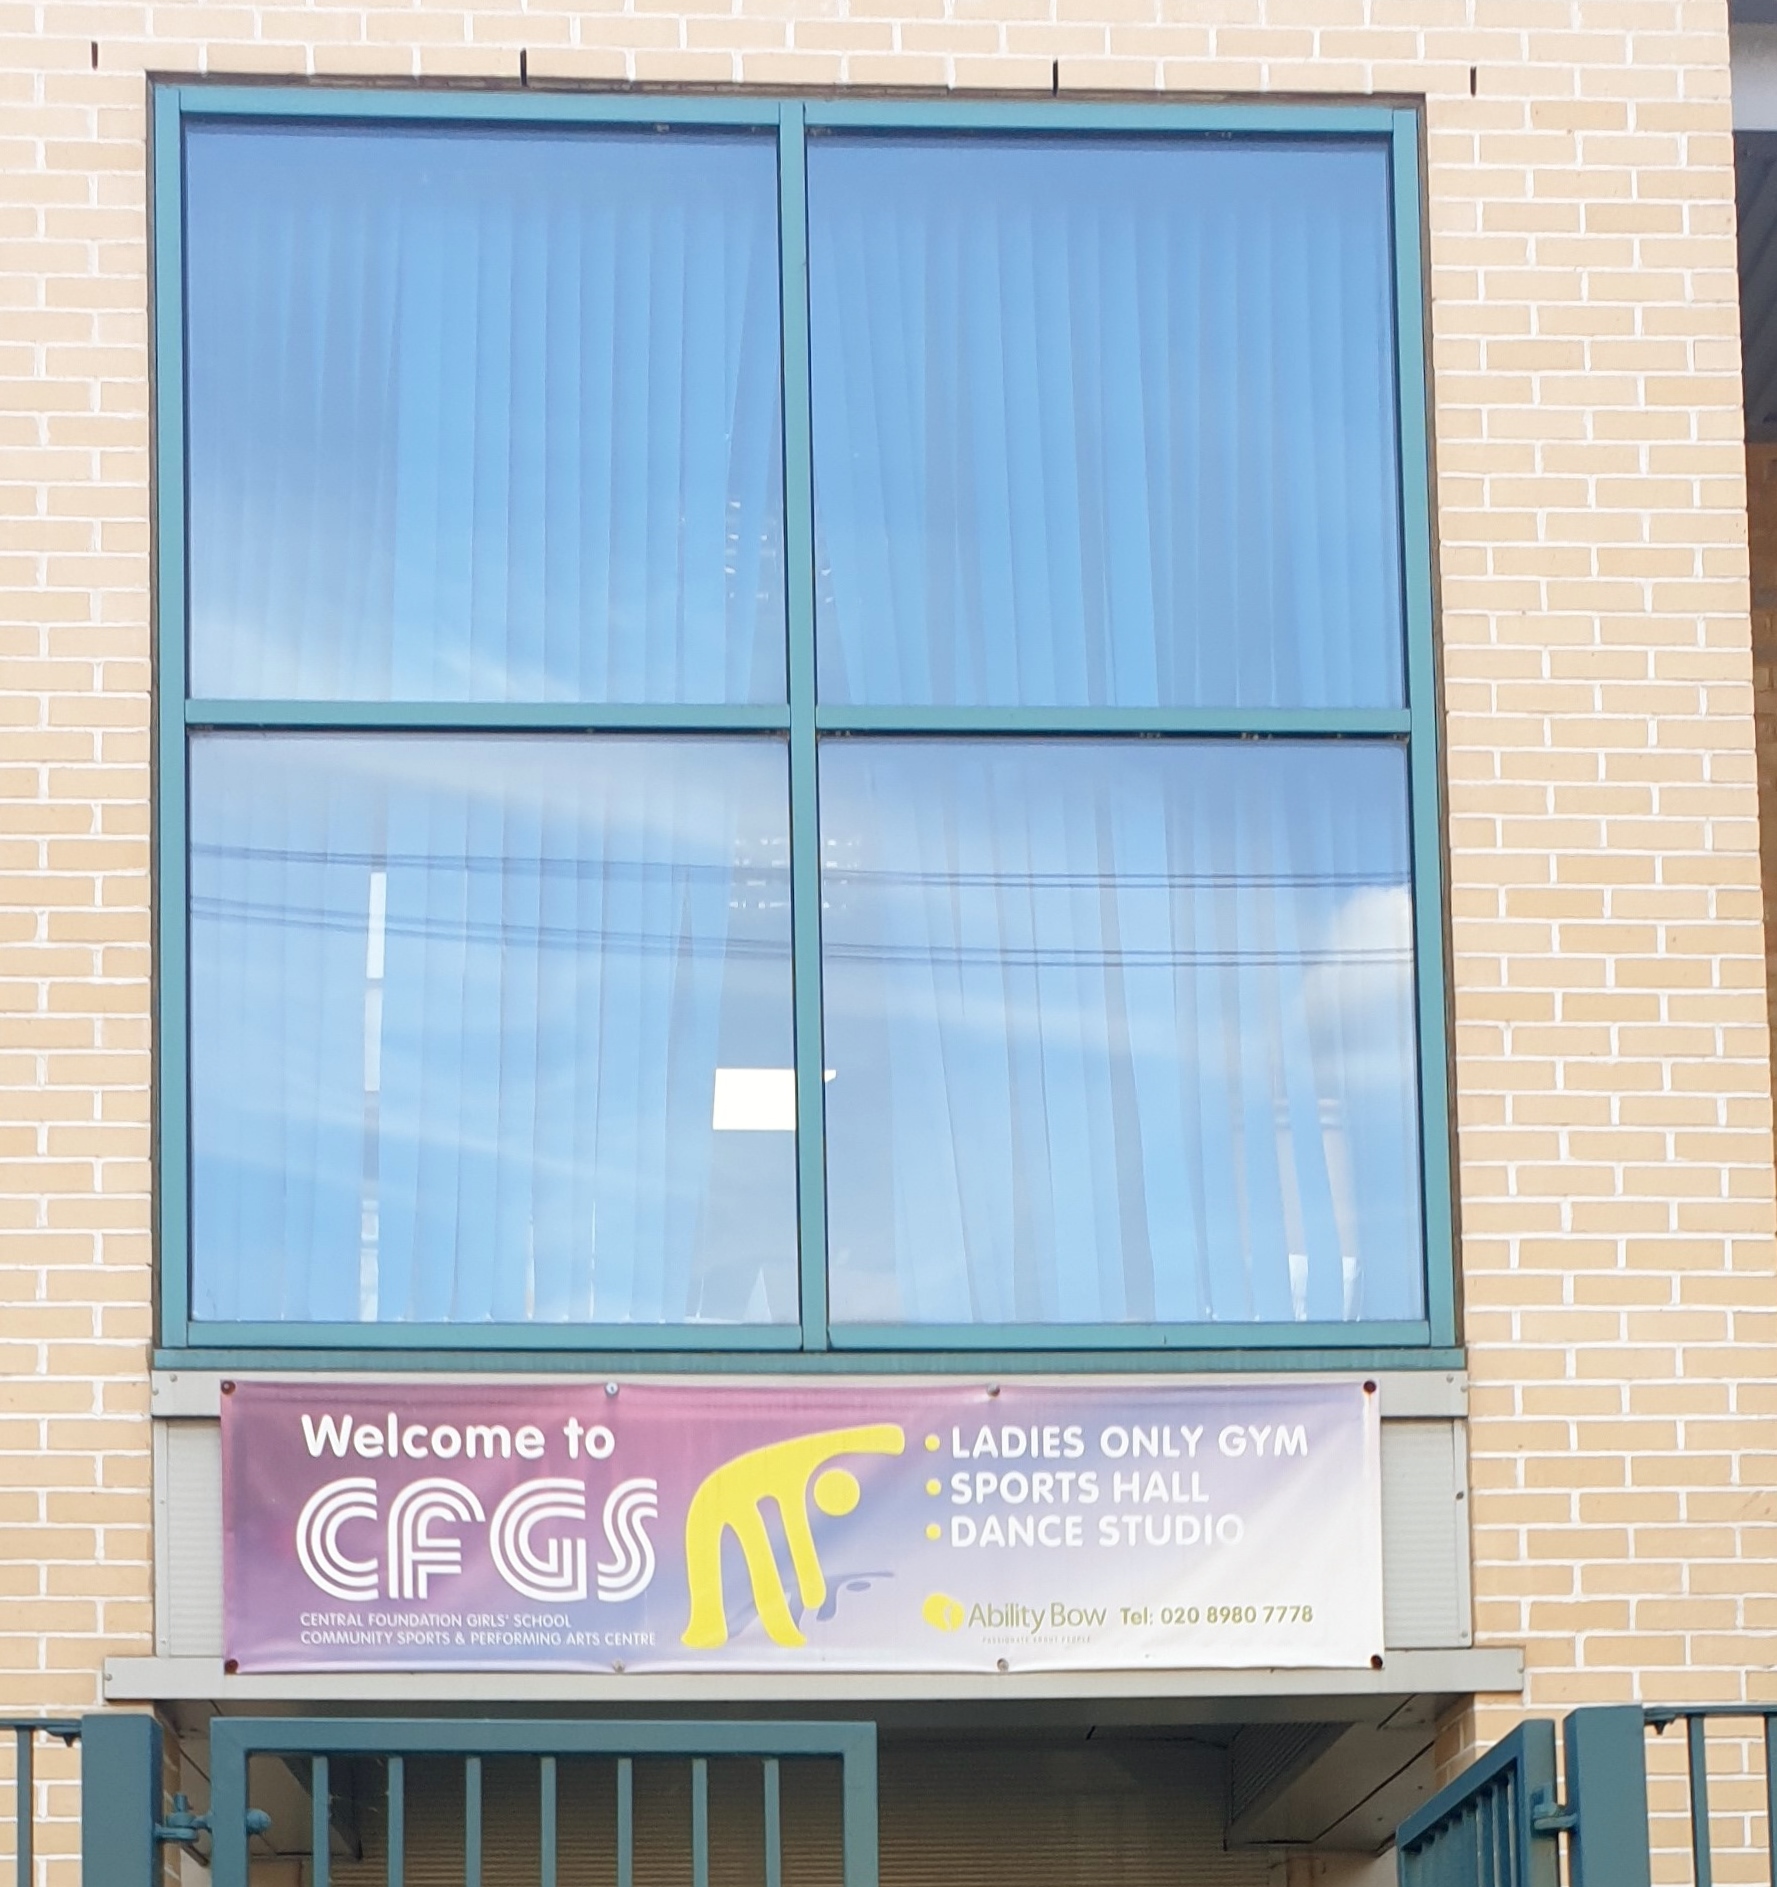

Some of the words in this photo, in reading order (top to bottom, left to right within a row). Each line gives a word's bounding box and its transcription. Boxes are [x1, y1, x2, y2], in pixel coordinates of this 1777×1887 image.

[301, 1412, 545, 1459] Welcome
[563, 1416, 615, 1460] to
[951, 1425, 1085, 1458] LADIES
[1100, 1424, 1204, 1458] ONLY
[1217, 1423, 1309, 1457] GYM
[951, 1471, 1099, 1505] SPORTS
[1113, 1470, 1210, 1504] HALL
[296, 1477, 658, 1602] CFGS
[951, 1515, 1084, 1548] DANCE
[1099, 1513, 1245, 1547] STUDIO
[300, 1612, 364, 1627] CENTRAL
[368, 1613, 463, 1627] FOUNDATION
[466, 1613, 509, 1628] GIRLS'
[513, 1614, 572, 1628] SCHOOL
[968, 1602, 1045, 1635] Ability
[1050, 1601, 1107, 1627] Bow
[1120, 1607, 1155, 1626] Tel:
[1160, 1606, 1200, 1625] 020
[1206, 1606, 1257, 1625] 8980
[1263, 1604, 1314, 1624] 7778
[301, 1630, 394, 1645] COMMUNITY
[397, 1631, 451, 1645] SPORTS
[454, 1632, 466, 1645] &
[471, 1631, 562, 1646] PERFORMING
[565, 1632, 601, 1646] ARTS
[604, 1632, 657, 1647] CENTRE
